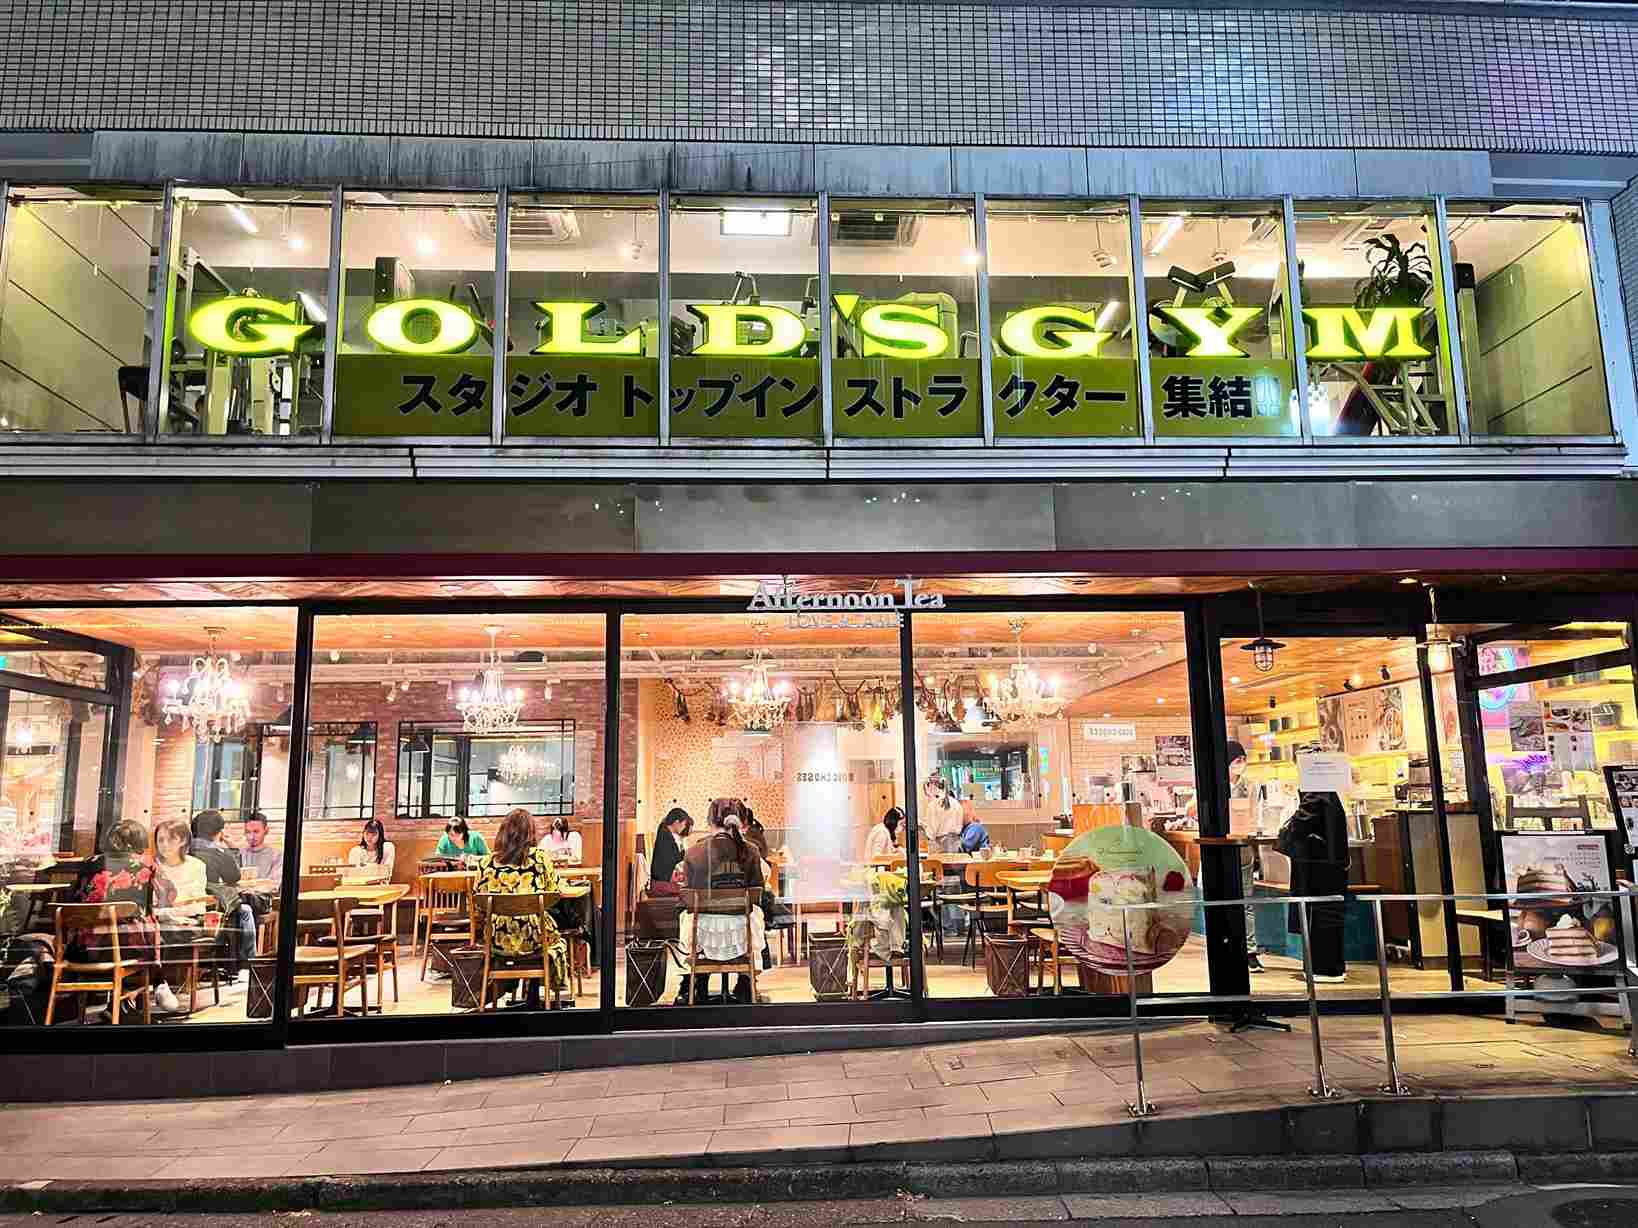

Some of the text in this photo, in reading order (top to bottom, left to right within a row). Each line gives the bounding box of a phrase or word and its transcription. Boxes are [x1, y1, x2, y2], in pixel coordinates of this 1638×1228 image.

[190, 294, 1434, 360] GOLD'S GYM
[399, 374, 597, 417] スタジオ
[746, 576, 945, 610] Afternoon Tea
